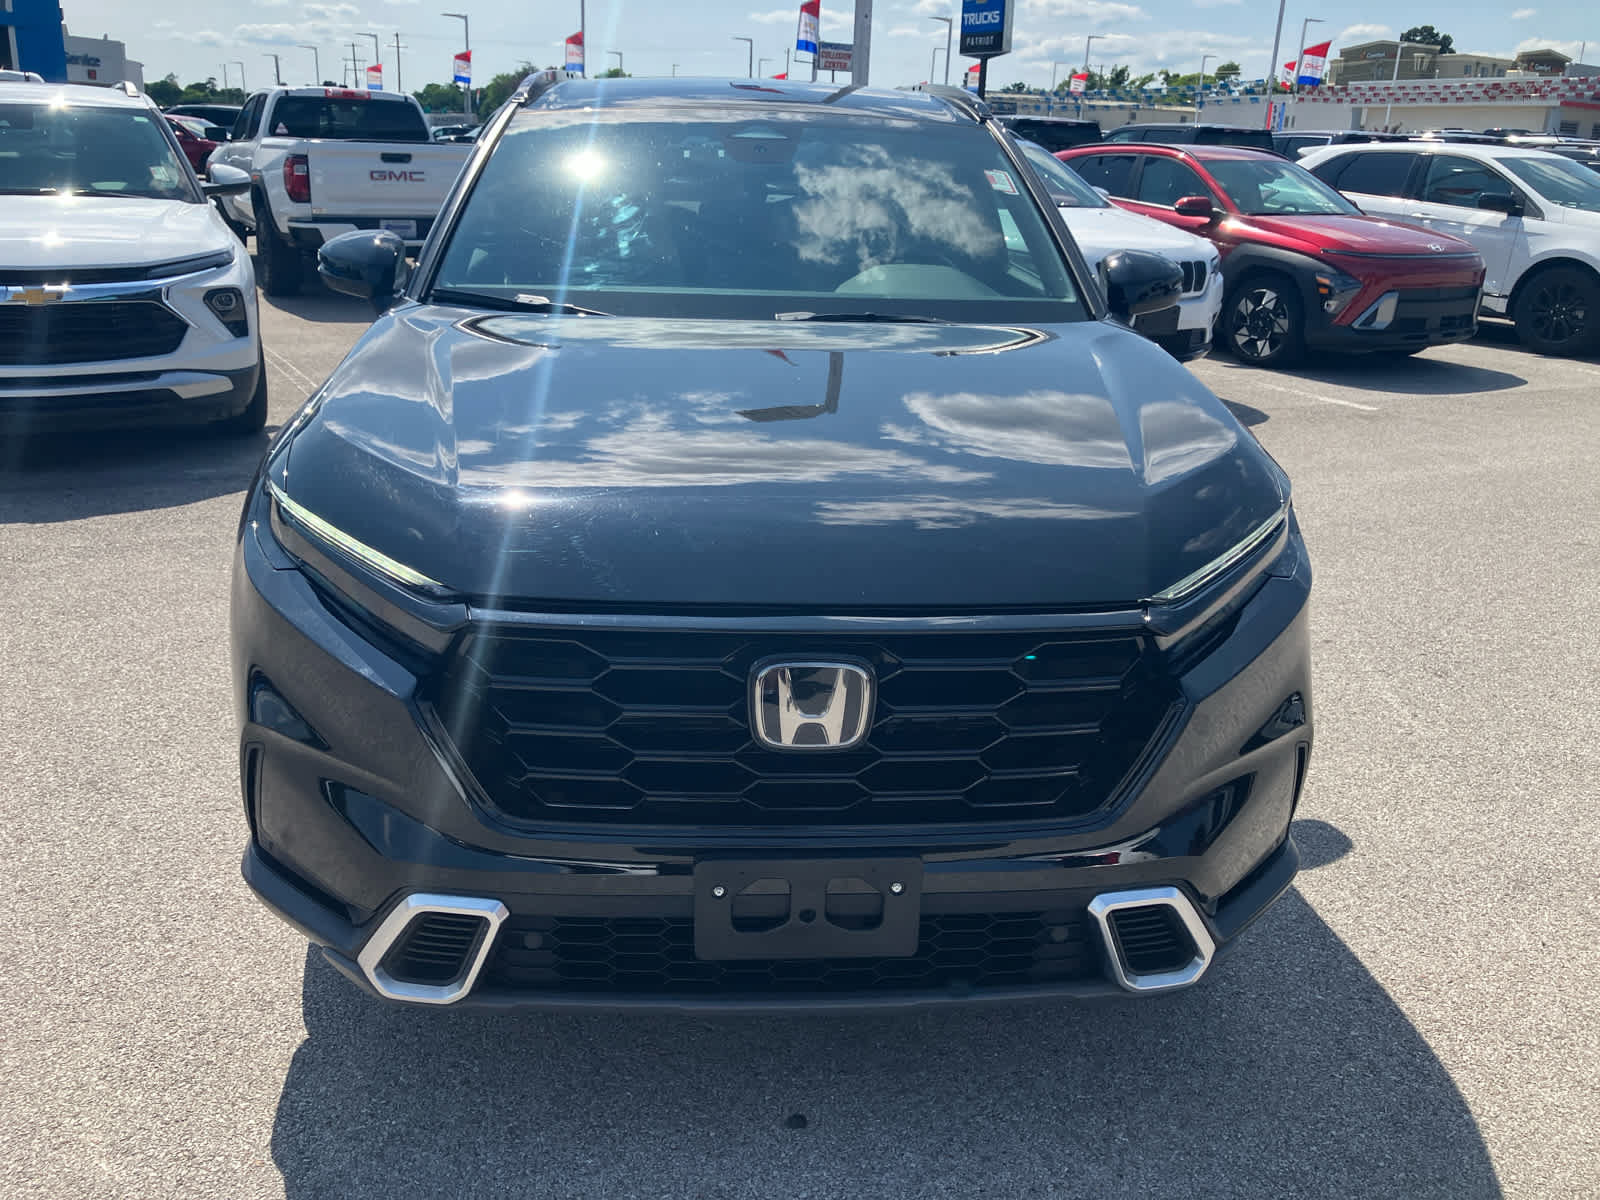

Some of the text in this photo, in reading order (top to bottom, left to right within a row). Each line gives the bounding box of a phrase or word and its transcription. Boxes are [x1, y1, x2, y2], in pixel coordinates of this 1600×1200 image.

[963, 10, 1000, 26] TRUCKS
[966, 35, 994, 46] PATRIOT
[823, 60, 848, 69] CENTER
[369, 170, 425, 182] GMC
